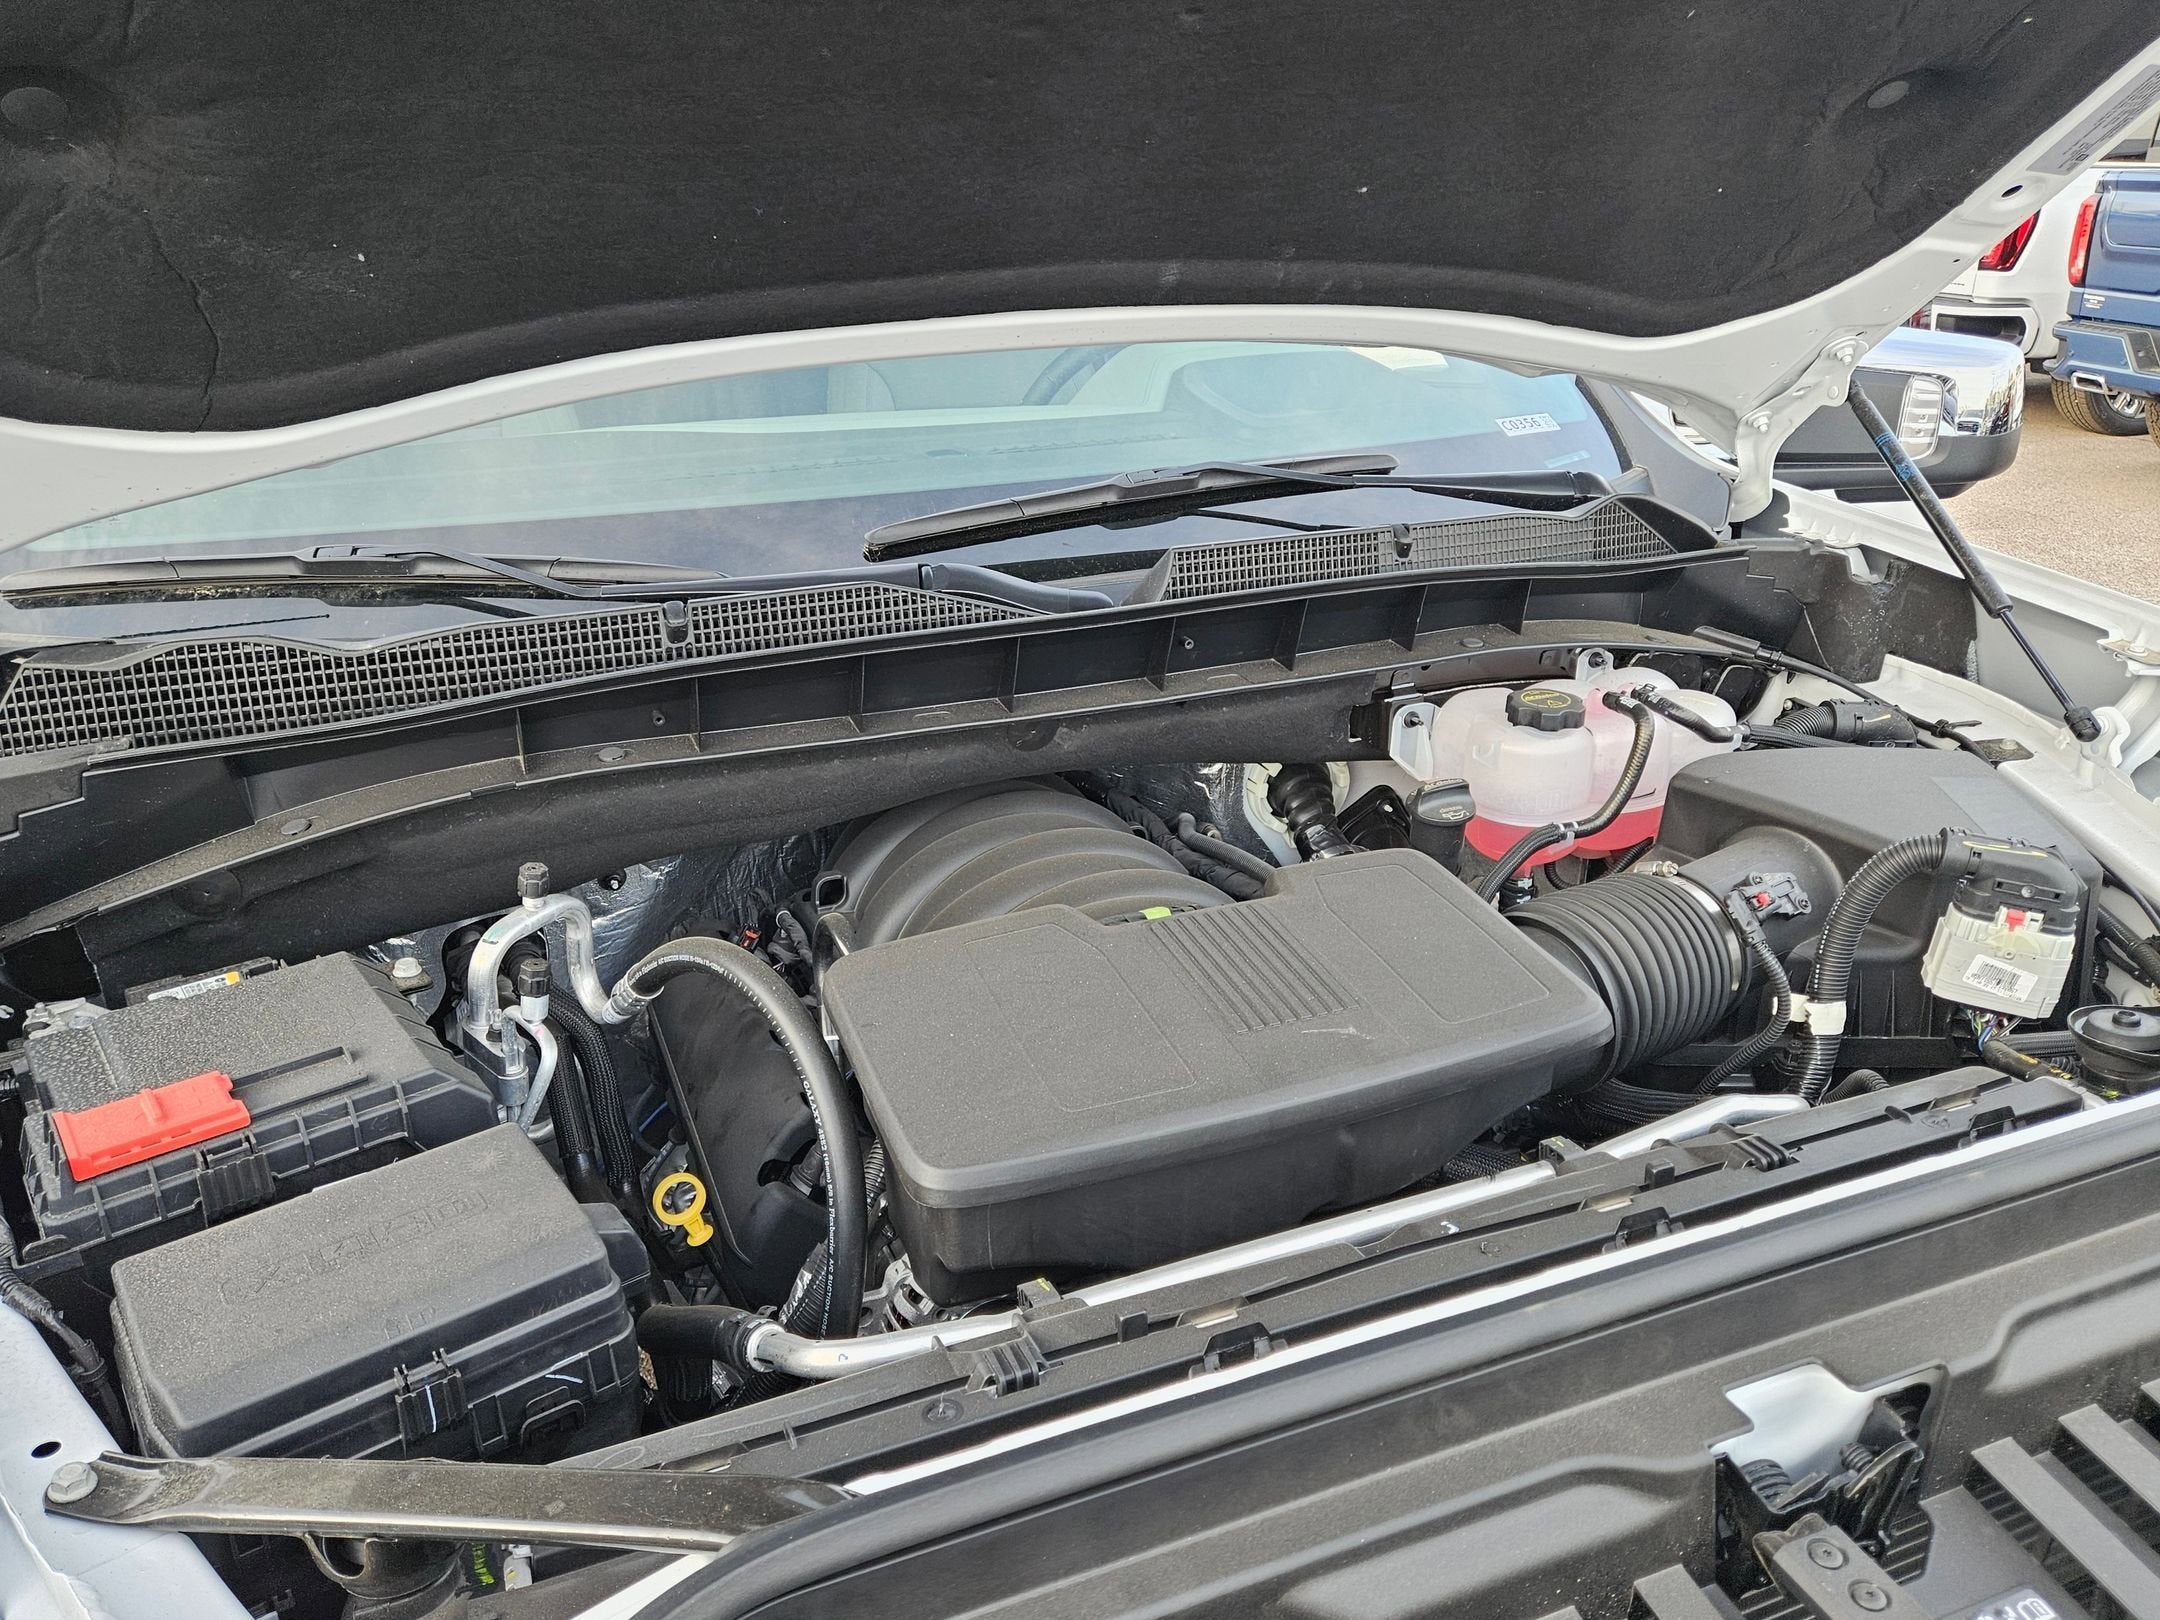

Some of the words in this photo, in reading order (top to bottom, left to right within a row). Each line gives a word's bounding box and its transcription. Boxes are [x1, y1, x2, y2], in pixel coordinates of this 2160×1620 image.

[1501, 417, 1541, 431] C0356
[803, 1080, 822, 1126] GALAXY
[828, 1208, 836, 1255] Flexbarrier
[823, 1274, 834, 1312] SUCTION
